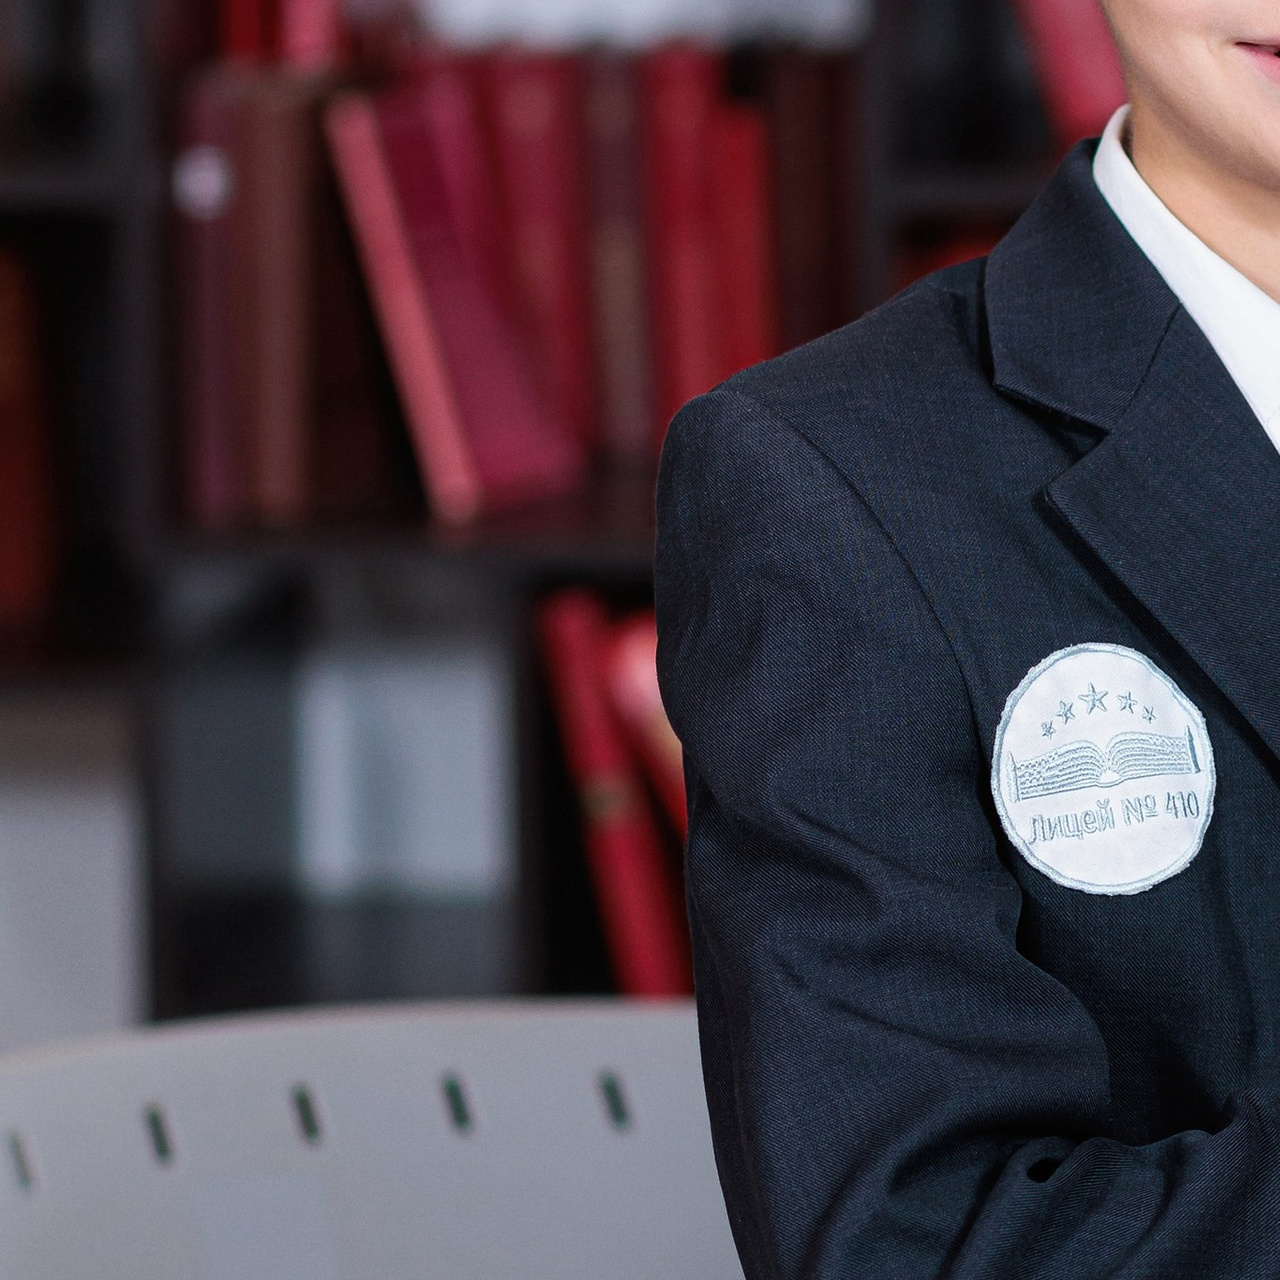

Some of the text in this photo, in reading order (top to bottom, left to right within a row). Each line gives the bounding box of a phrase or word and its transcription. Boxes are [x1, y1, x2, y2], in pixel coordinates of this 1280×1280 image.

[1028, 790, 1200, 845] Лицей № 410
